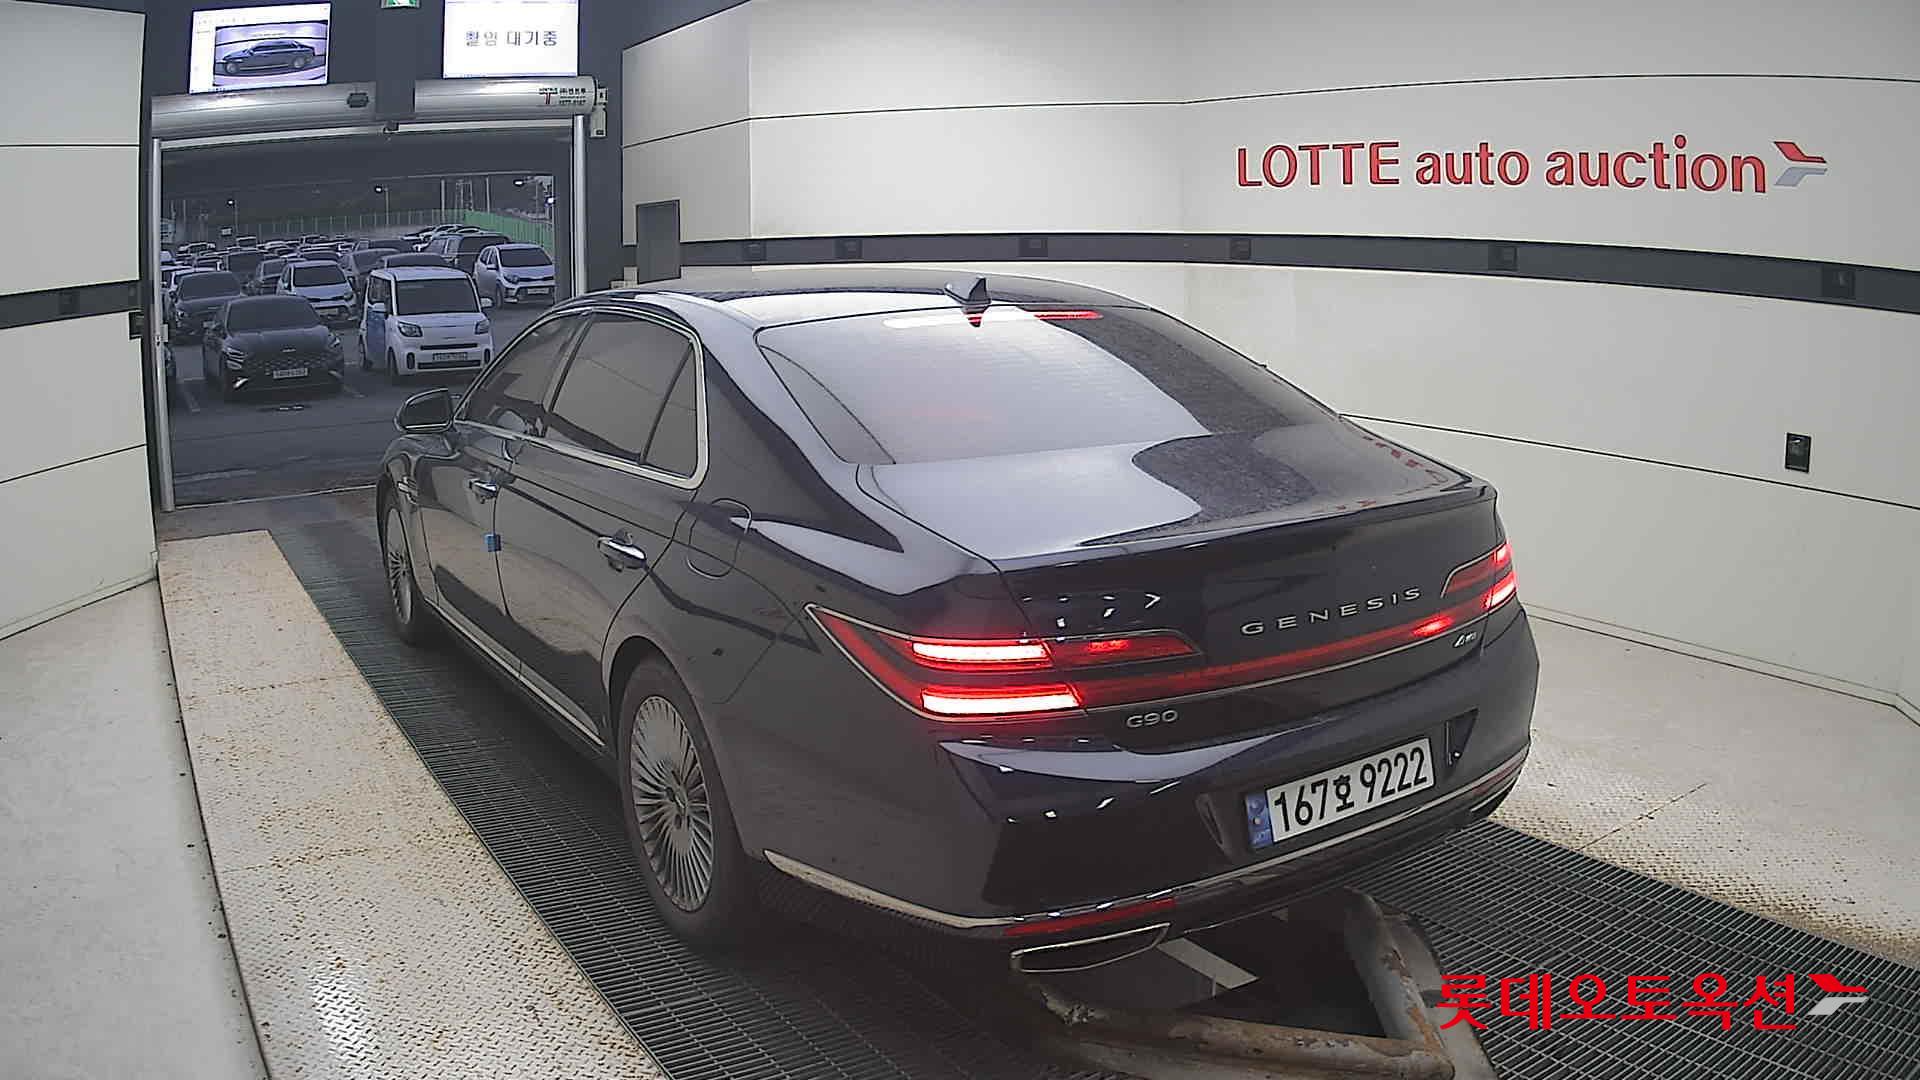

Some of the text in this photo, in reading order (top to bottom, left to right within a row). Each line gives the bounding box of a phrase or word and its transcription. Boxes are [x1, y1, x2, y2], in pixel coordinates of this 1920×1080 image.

[507, 30, 558, 47] 대기중
[1237, 134, 1767, 194] LOTTE auto auction
[1240, 587, 1421, 637] GENESIS
[1126, 709, 1178, 729] G90
[1273, 746, 1427, 833] 167호 9222
